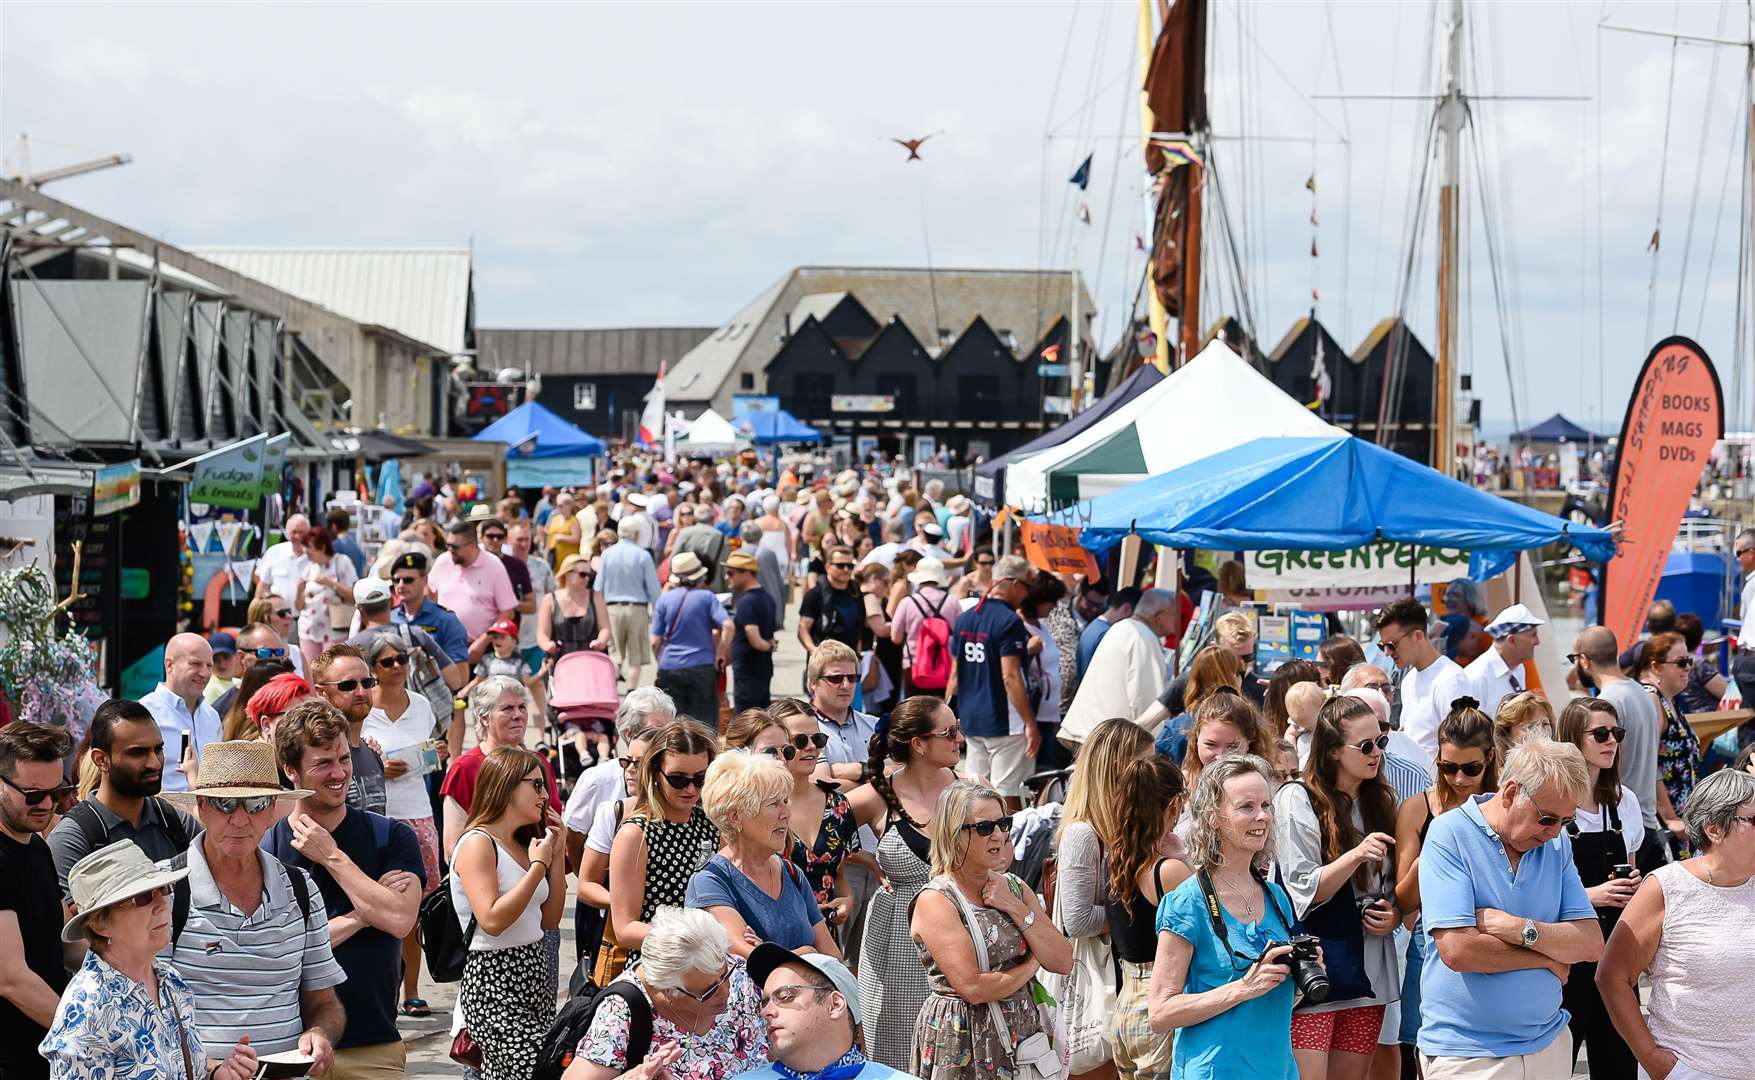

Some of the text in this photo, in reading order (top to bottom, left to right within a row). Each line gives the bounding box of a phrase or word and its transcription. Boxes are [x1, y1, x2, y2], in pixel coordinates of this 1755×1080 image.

[1662, 395, 1710, 412] BOOKS
[1661, 421, 1703, 438] MAGS
[1660, 445, 1695, 462] DVDs
[202, 467, 253, 485] Fudge
[197, 486, 253, 500] & treats
[965, 642, 985, 663] 96
[1208, 894, 1219, 917] Nikon
